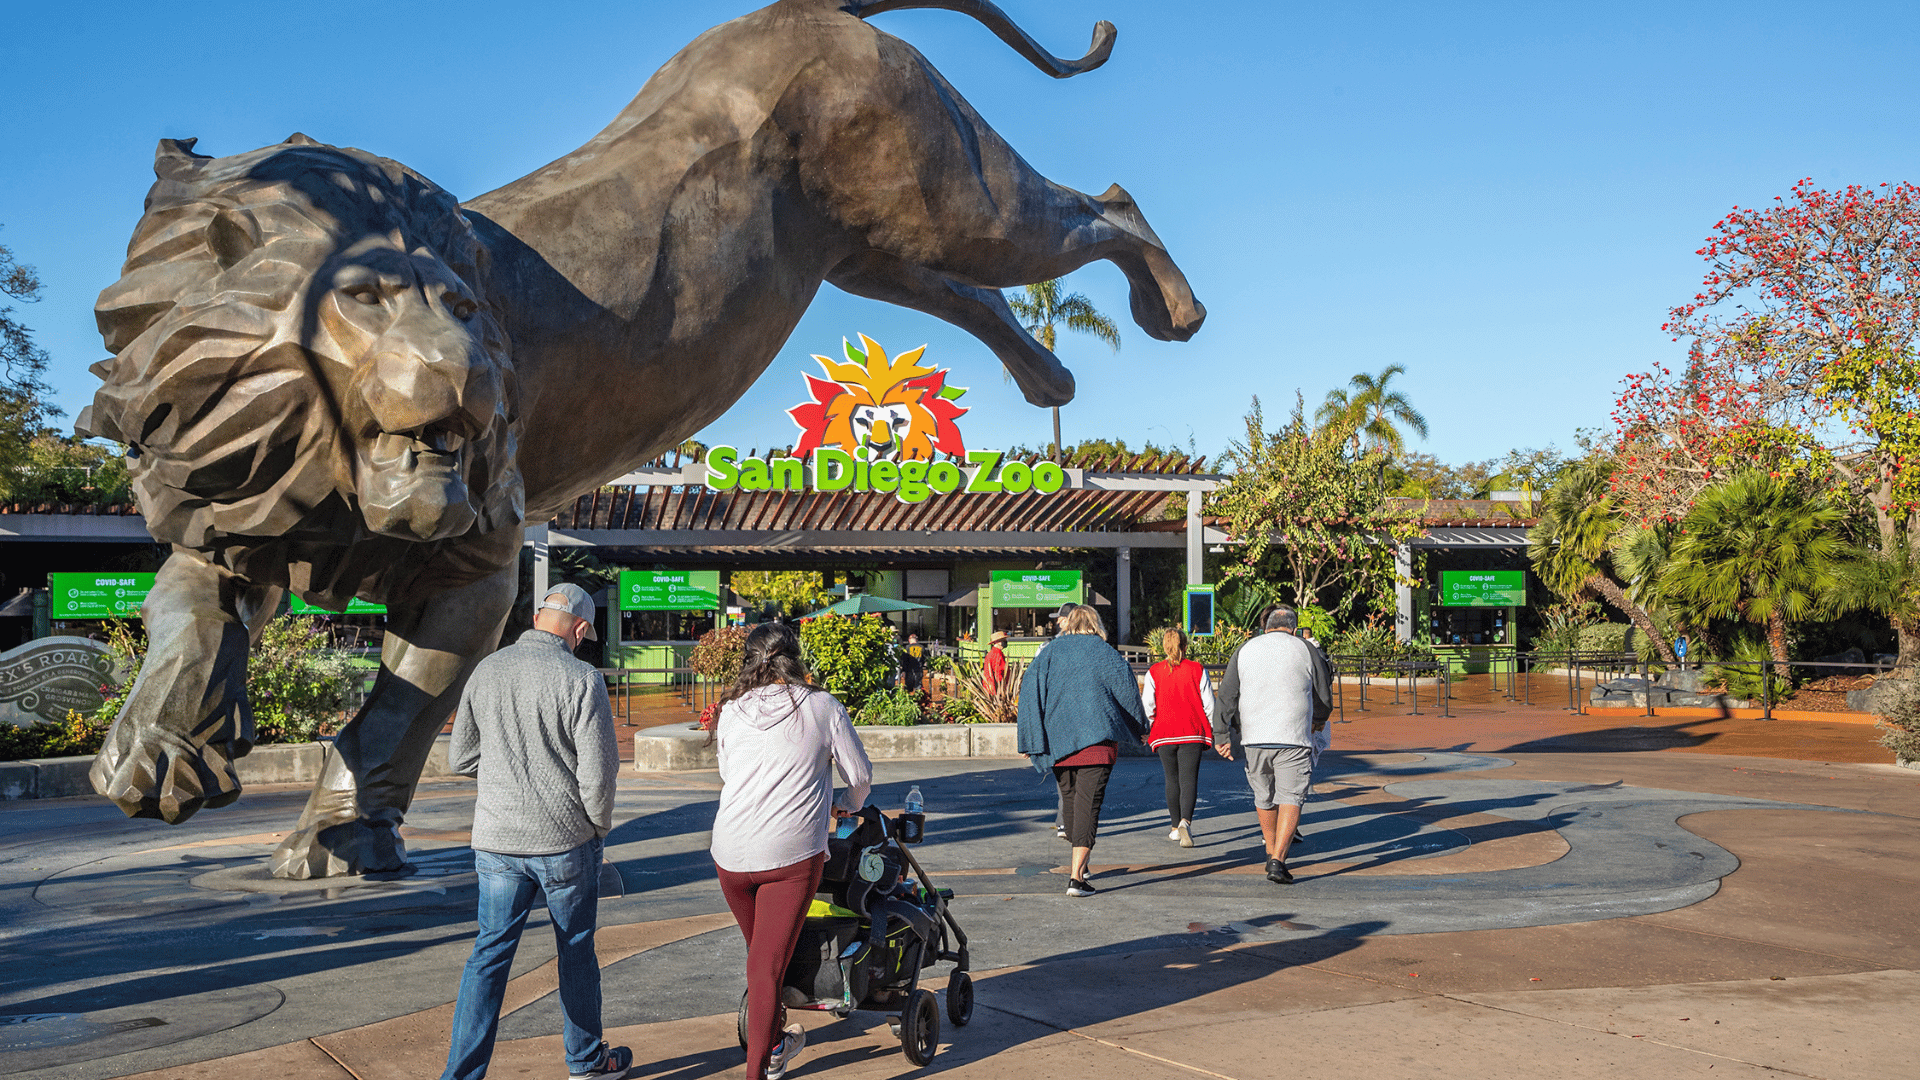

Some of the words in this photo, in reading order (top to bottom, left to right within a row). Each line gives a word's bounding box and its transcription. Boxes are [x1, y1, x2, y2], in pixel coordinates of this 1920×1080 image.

[706, 445, 803, 493] San
[813, 446, 961, 503] Diego
[965, 450, 1065, 494] Zoo
[95, 578, 136, 586] COVID-SAFE
[40, 653, 90, 667] ROAR
